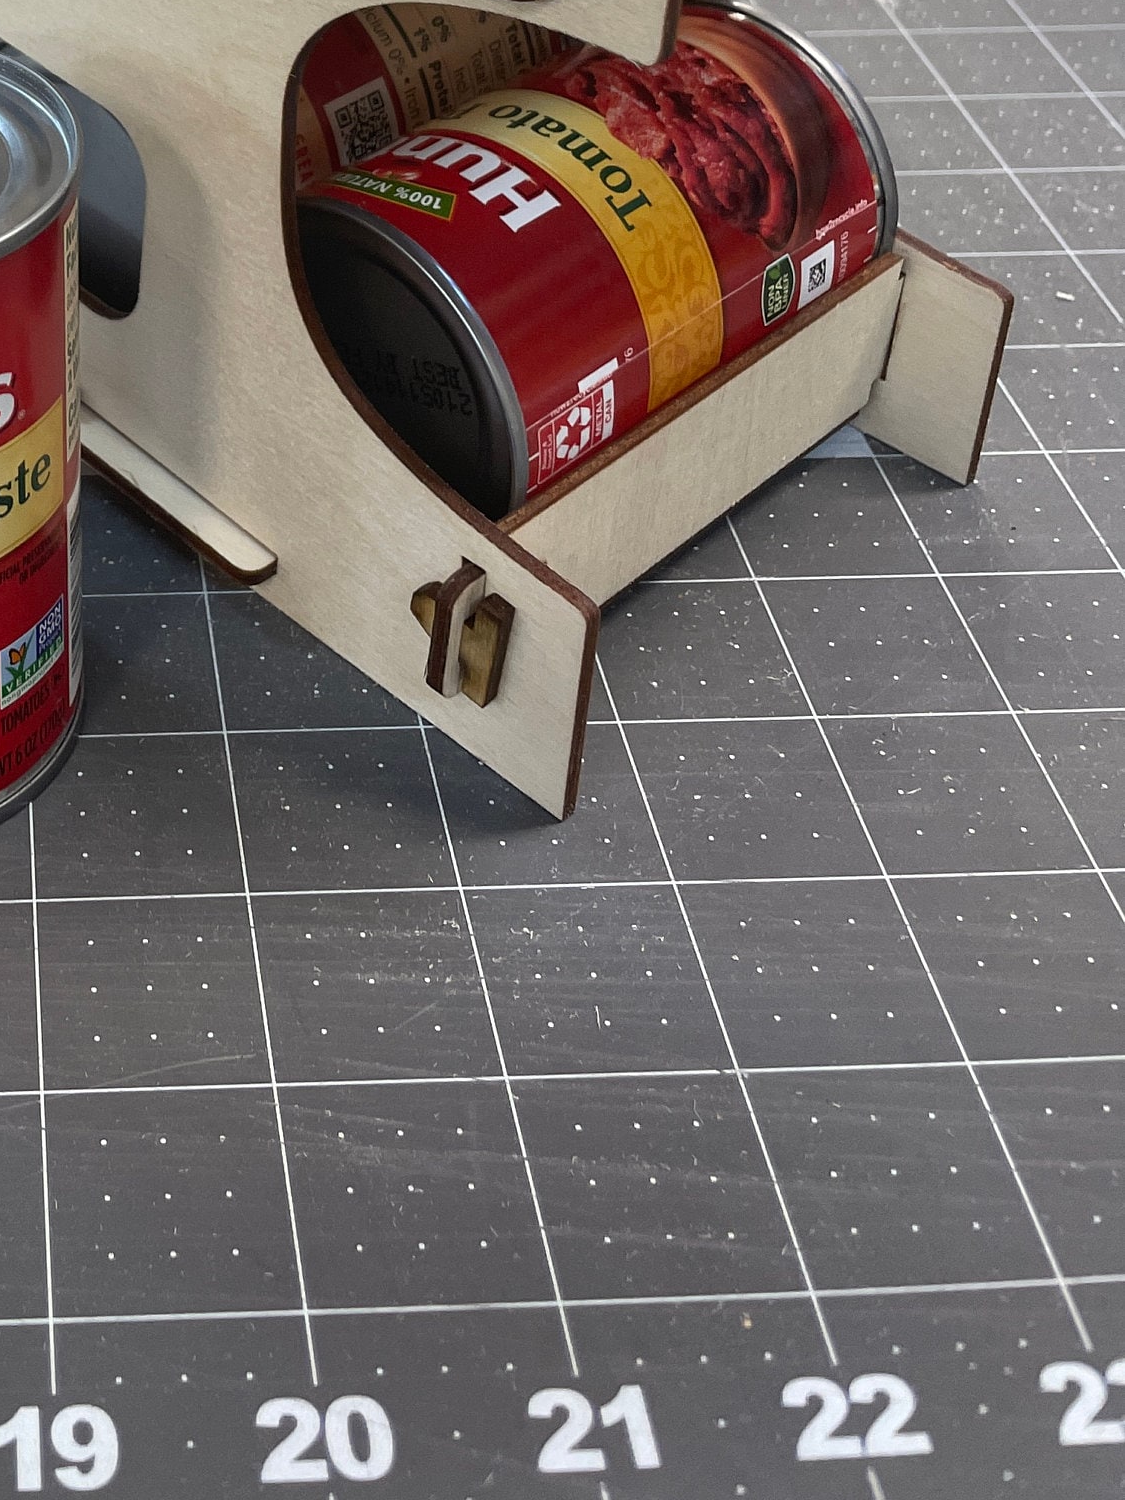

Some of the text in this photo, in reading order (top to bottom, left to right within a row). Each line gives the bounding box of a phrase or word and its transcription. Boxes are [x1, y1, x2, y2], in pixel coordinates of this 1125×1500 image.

[488, 102, 655, 232] Tomato
[396, 185, 443, 211] 100%
[767, 283, 776, 318] NON
[773, 276, 784, 314] BPA
[594, 396, 604, 438] METAL
[604, 398, 613, 424] CAN
[38, 603, 62, 635] NON
[38, 615, 62, 646] GMO
[4, 636, 63, 694] VERIFIED
[14, 746, 24, 766] 6
[24, 734, 38, 759] OZ
[527, 1384, 662, 1473] 21
[782, 1372, 933, 1462] 22
[255, 1395, 394, 1484] 20
